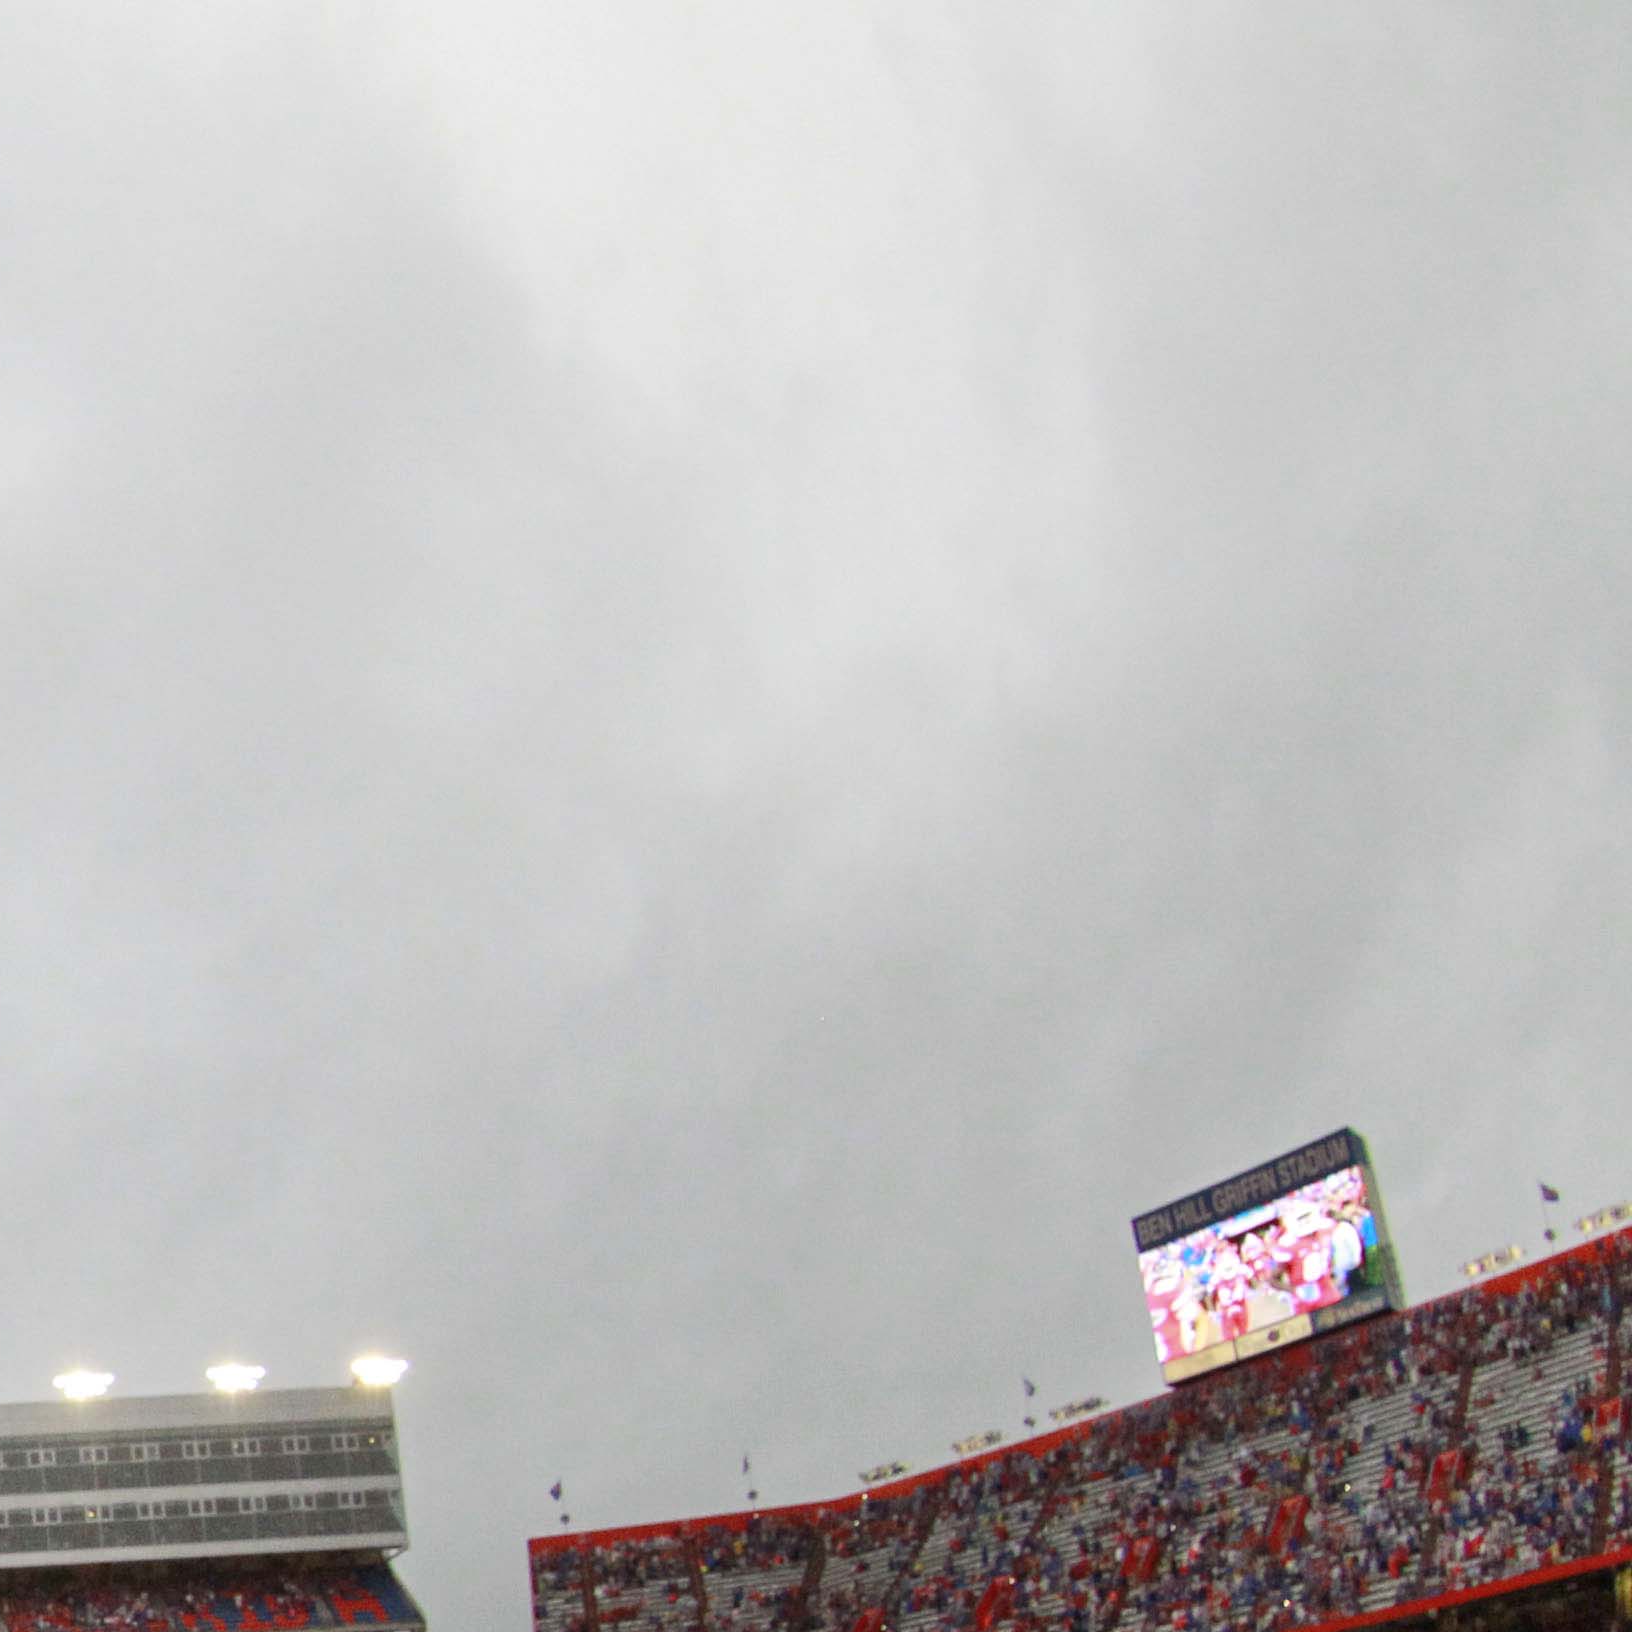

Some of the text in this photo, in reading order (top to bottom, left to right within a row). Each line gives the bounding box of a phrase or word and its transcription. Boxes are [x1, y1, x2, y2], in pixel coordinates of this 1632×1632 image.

[1138, 1136, 1349, 1244] BEN HILL GRIFFIN STADIUM
